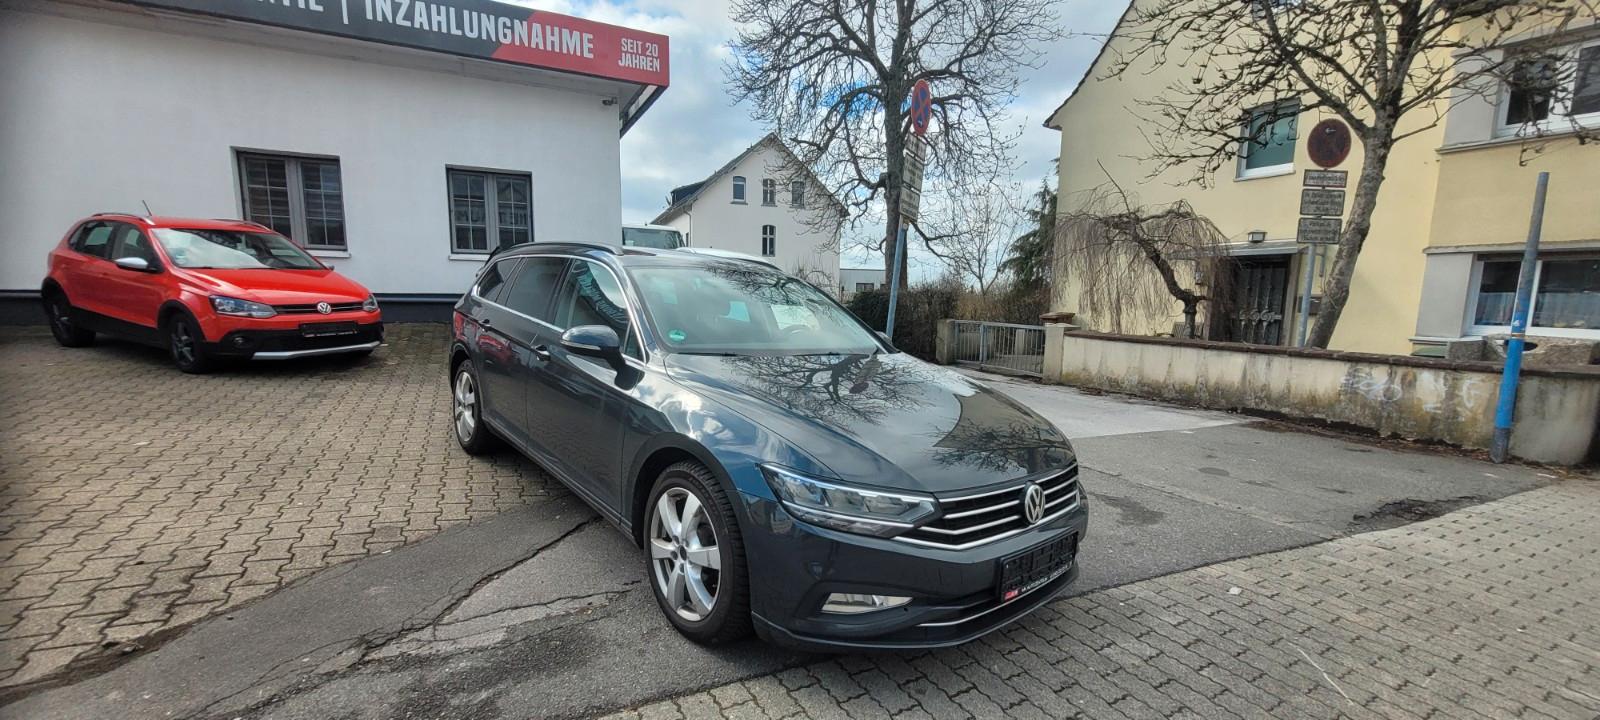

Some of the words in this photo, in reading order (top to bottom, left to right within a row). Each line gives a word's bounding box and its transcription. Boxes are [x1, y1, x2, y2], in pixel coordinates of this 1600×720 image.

[365, 0, 594, 59] INZAHLUNGNAHME
[621, 38, 642, 54] SEIT
[645, 42, 659, 57] 20
[618, 52, 660, 72] JAHREN
